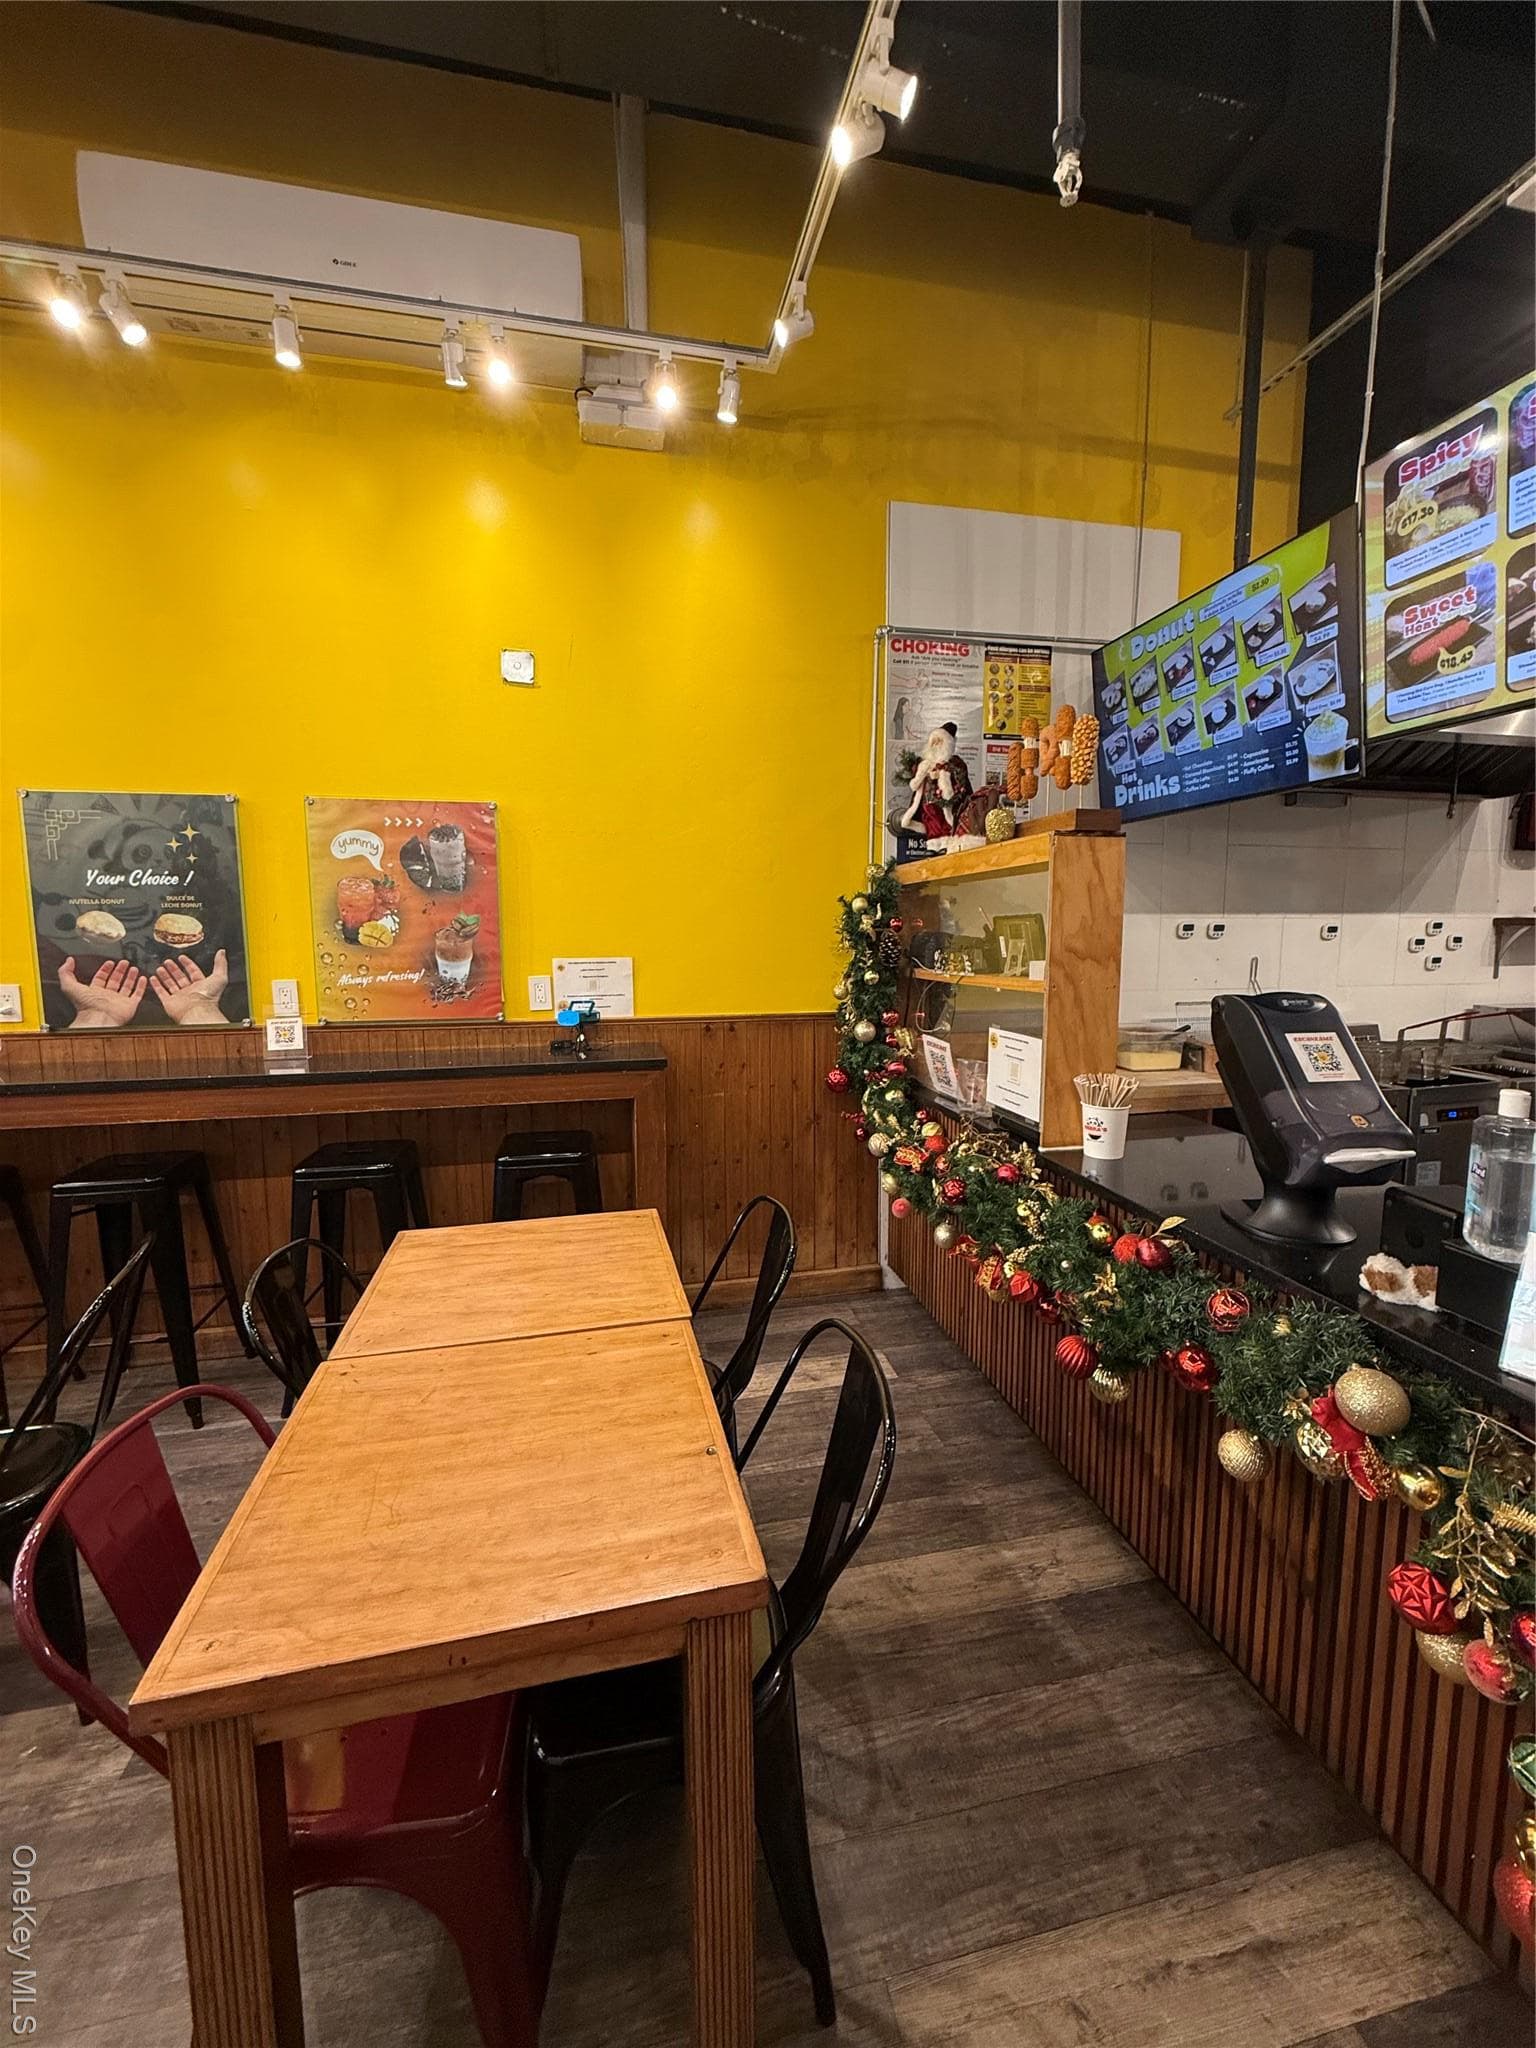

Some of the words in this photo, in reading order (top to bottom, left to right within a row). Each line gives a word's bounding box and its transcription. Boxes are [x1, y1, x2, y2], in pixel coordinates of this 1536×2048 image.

[1399, 424, 1483, 486] Spicy
[1404, 585, 1476, 624] Sweet
[1131, 608, 1194, 661] Donut
[891, 639, 970, 657] CHOKING
[1115, 774, 1180, 807] Drinks
[338, 837, 379, 856] yummy
[908, 839, 918, 849] No
[86, 869, 125, 887] Your
[129, 868, 179, 886] Choice
[184, 870, 194, 886] !
[337, 974, 372, 988] Always
